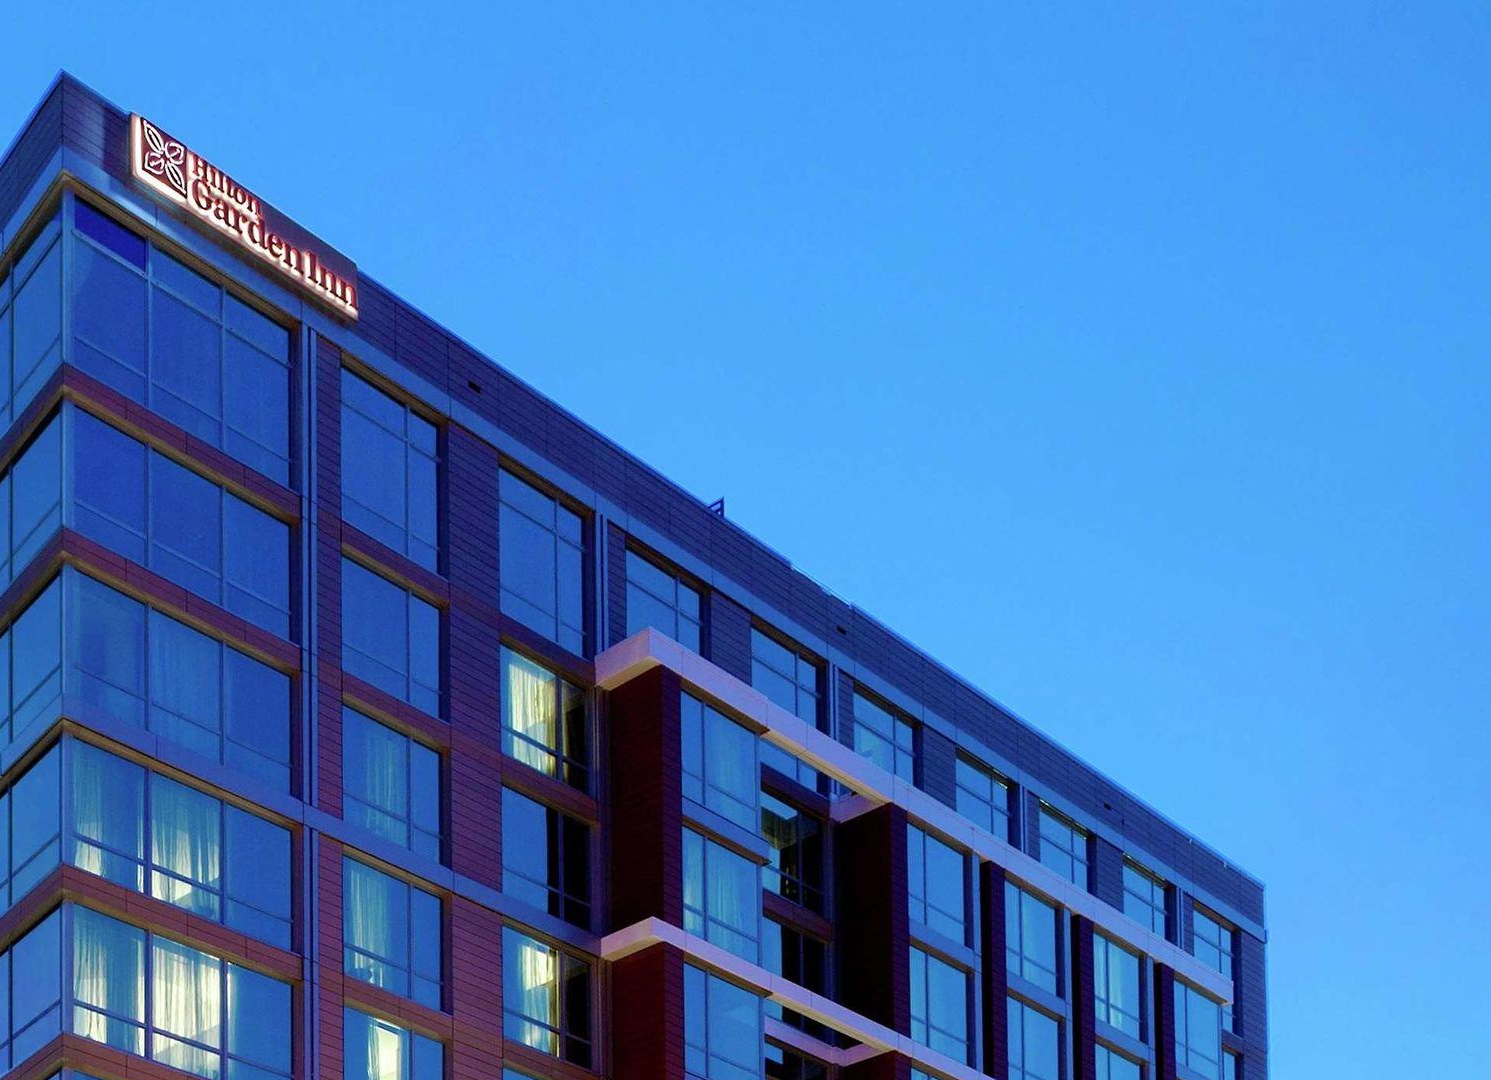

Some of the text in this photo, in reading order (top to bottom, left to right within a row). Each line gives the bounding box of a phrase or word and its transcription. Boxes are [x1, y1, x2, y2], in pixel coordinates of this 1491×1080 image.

[191, 154, 262, 216] Hilton
[191, 178, 359, 310] Garden Inn
